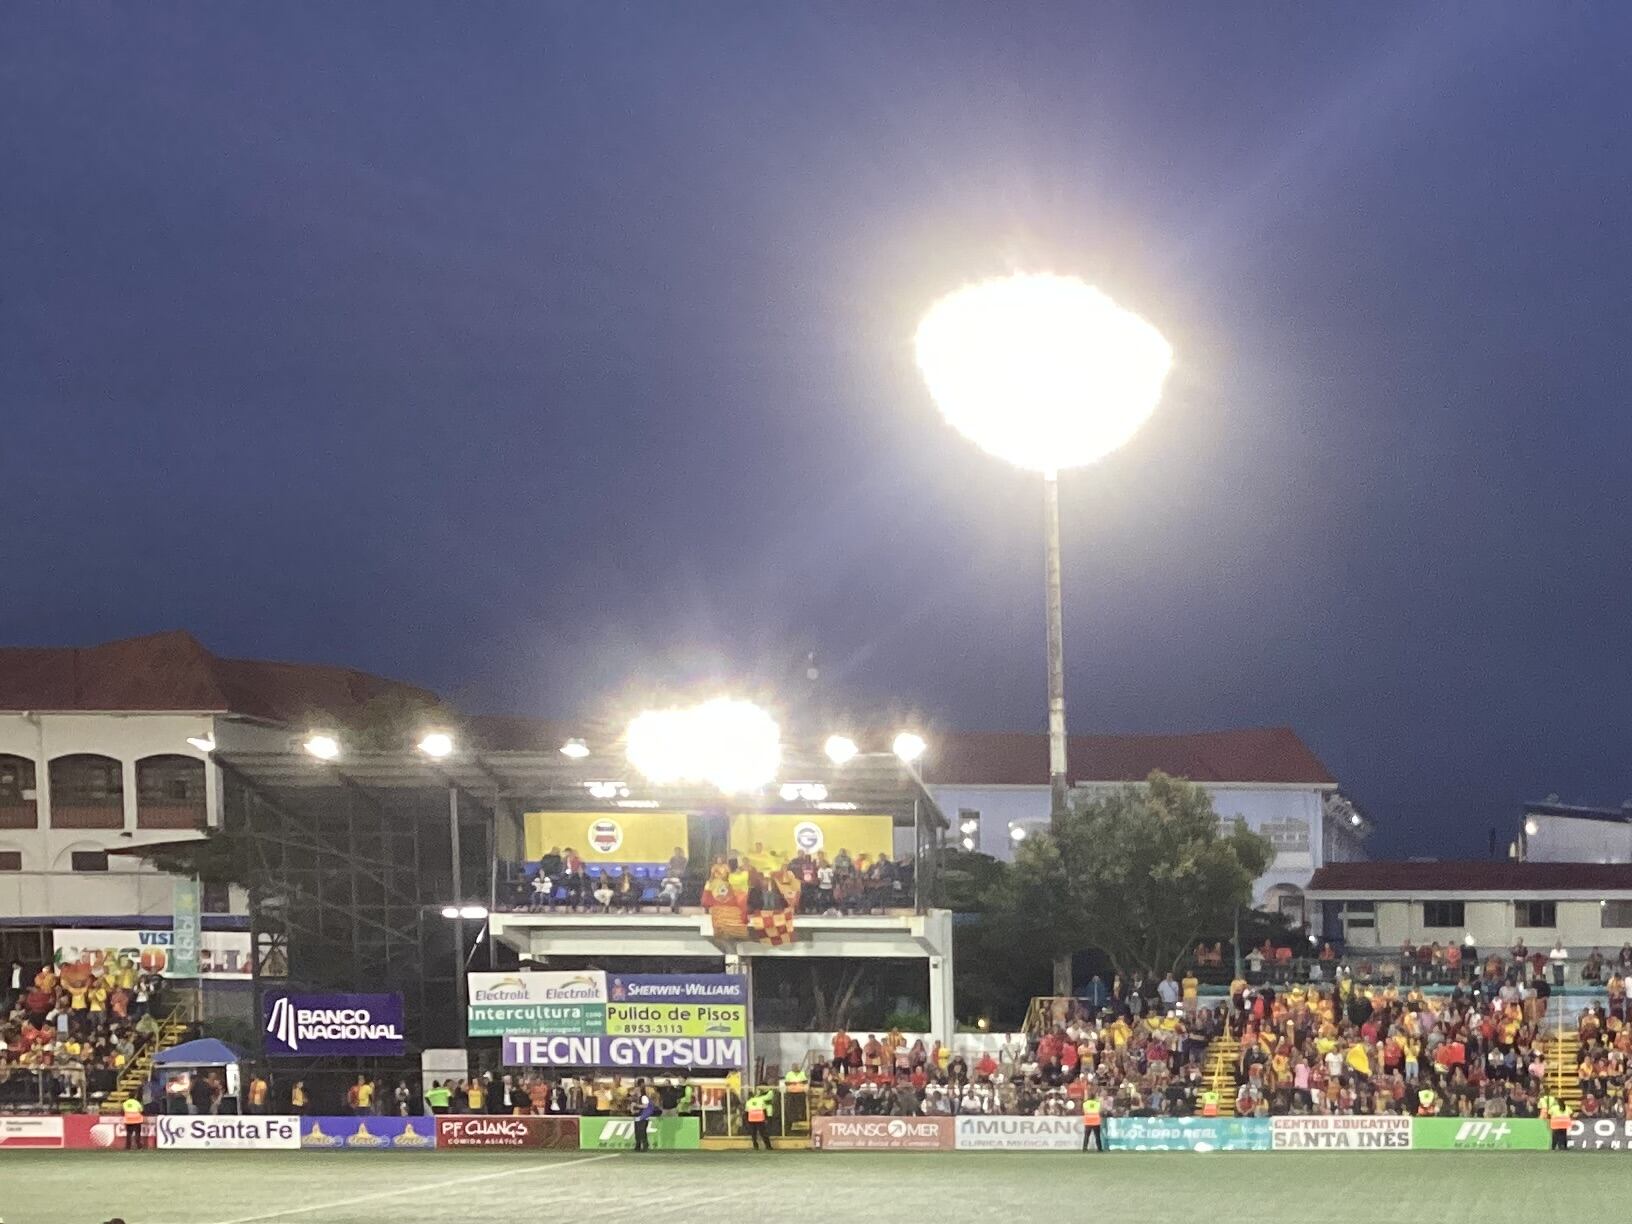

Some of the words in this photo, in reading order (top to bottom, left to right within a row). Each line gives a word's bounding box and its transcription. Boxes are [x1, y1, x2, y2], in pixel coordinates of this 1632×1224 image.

[475, 990, 529, 1001] Electrolit
[546, 988, 600, 1000] Electrolit
[628, 983, 741, 996] SHERWIN-WILLIAMS
[297, 1009, 370, 1024] BANCO
[468, 1005, 582, 1020] Intercultura
[608, 1007, 662, 1021] Pulido
[667, 1007, 691, 1021] de
[697, 1008, 740, 1021] Pisos
[297, 1025, 403, 1040] NACIONAL
[509, 1036, 601, 1065] TECNI
[609, 1037, 742, 1066] GYPSUM
[190, 1119, 260, 1139] Santa
[265, 1120, 293, 1140] Fe
[1274, 1119, 1329, 1129] CENTRO
[1333, 1119, 1410, 1129] EDUCATIVO
[1274, 1132, 1350, 1148] SANTA
